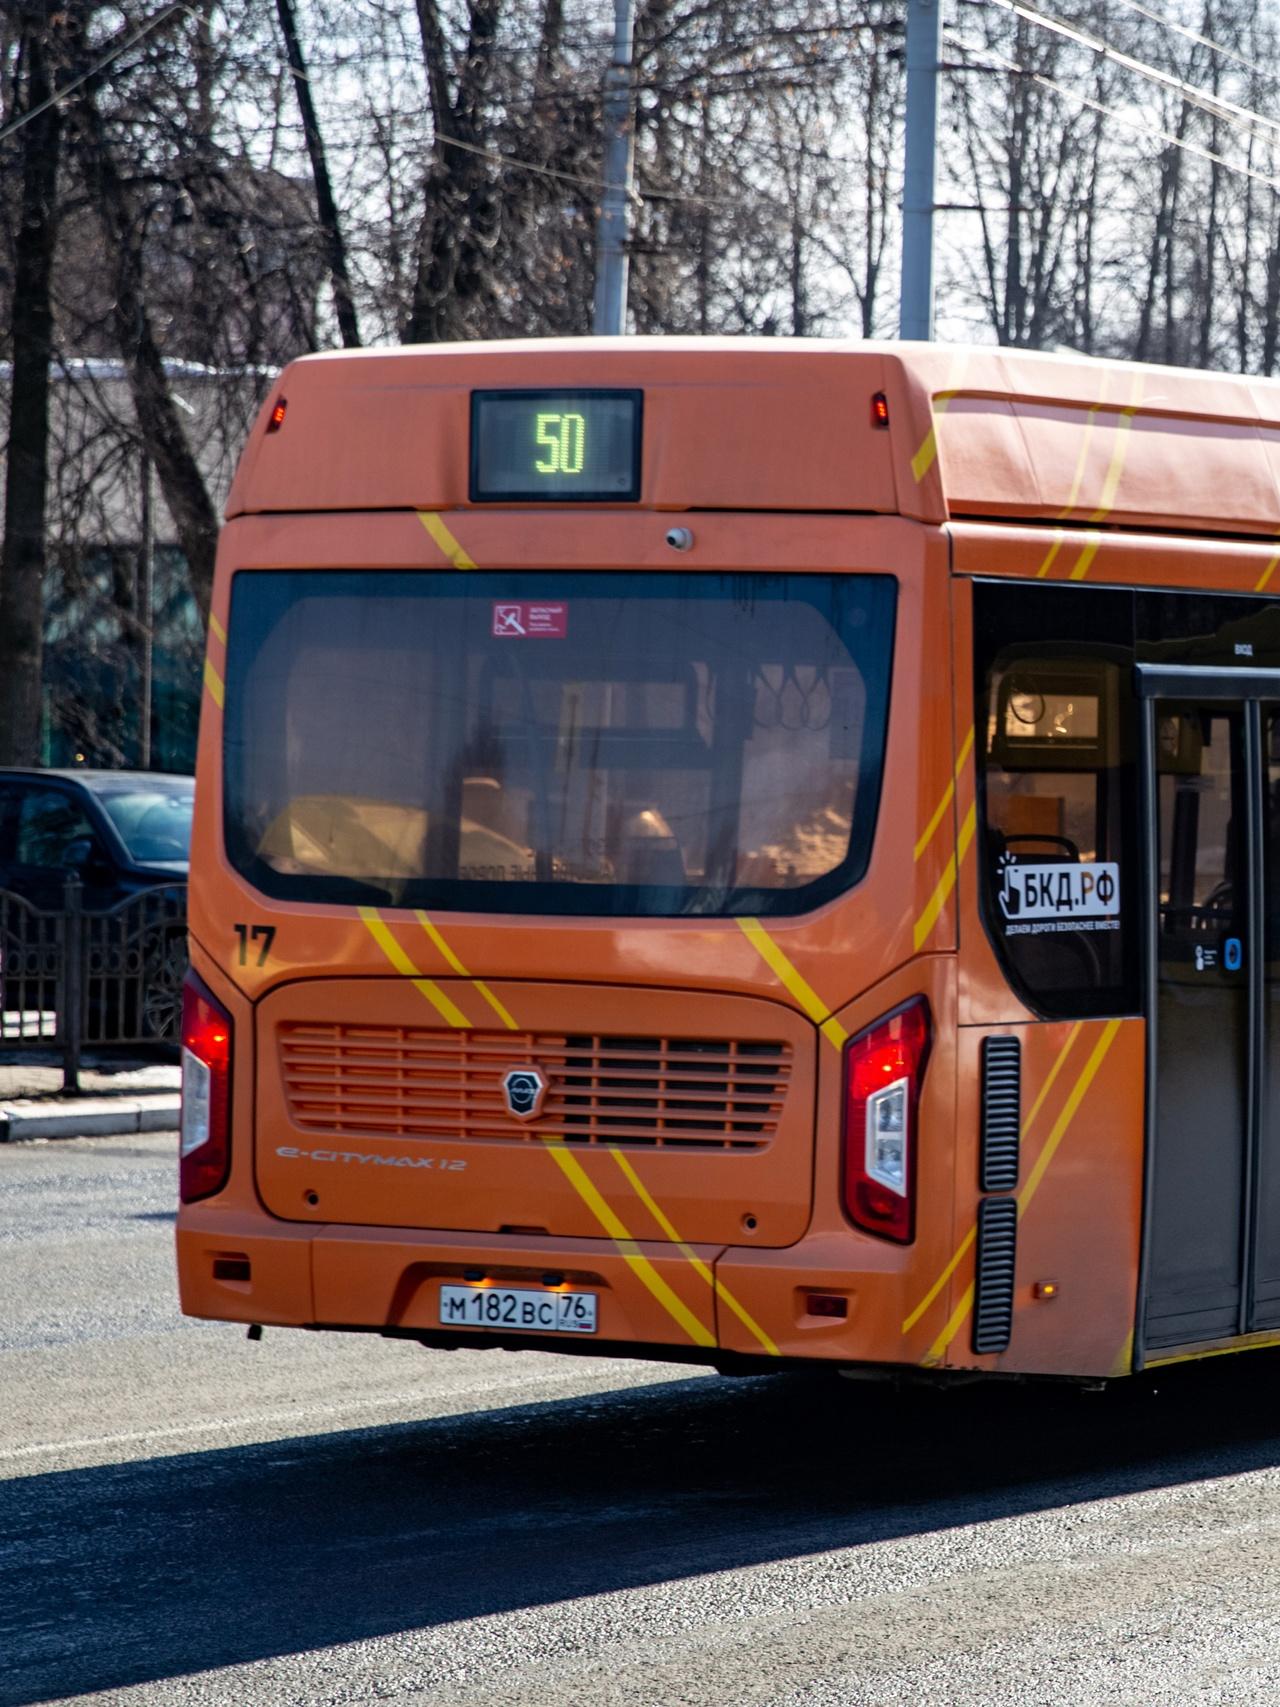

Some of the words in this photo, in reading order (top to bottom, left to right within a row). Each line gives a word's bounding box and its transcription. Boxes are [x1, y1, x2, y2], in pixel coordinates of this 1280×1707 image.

[536, 413, 585, 473] 50
[1025, 869, 1115, 912] БКД.РФ
[233, 924, 277, 968] 17
[438, 1159, 468, 1171] 12
[561, 1296, 587, 1318] 76
